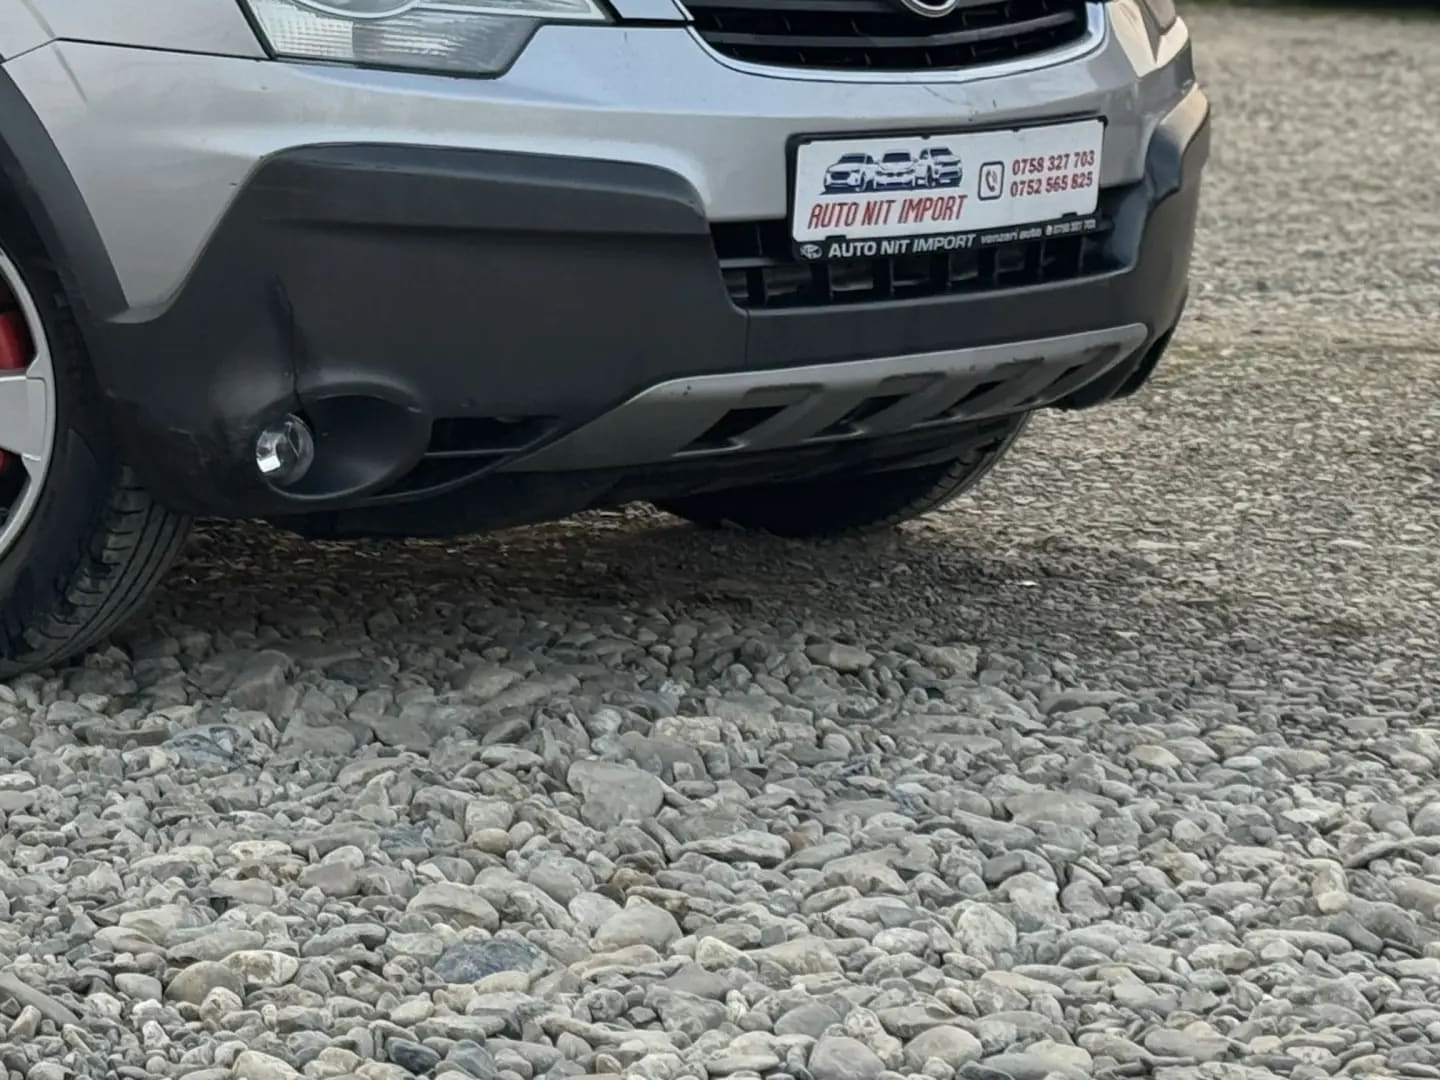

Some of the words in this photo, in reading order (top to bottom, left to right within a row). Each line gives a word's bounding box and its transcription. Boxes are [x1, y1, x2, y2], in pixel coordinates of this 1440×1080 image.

[1012, 157, 1045, 176] 0758
[1047, 153, 1071, 171] 327
[1074, 149, 1095, 168] 703
[1010, 178, 1042, 197] 0752
[808, 202, 859, 229] AUTO
[860, 199, 896, 226] NIT
[897, 195, 968, 224] IMPORT
[828, 242, 877, 258] AUTO
[880, 239, 910, 255] NIT
[912, 233, 976, 253] IMPORT
